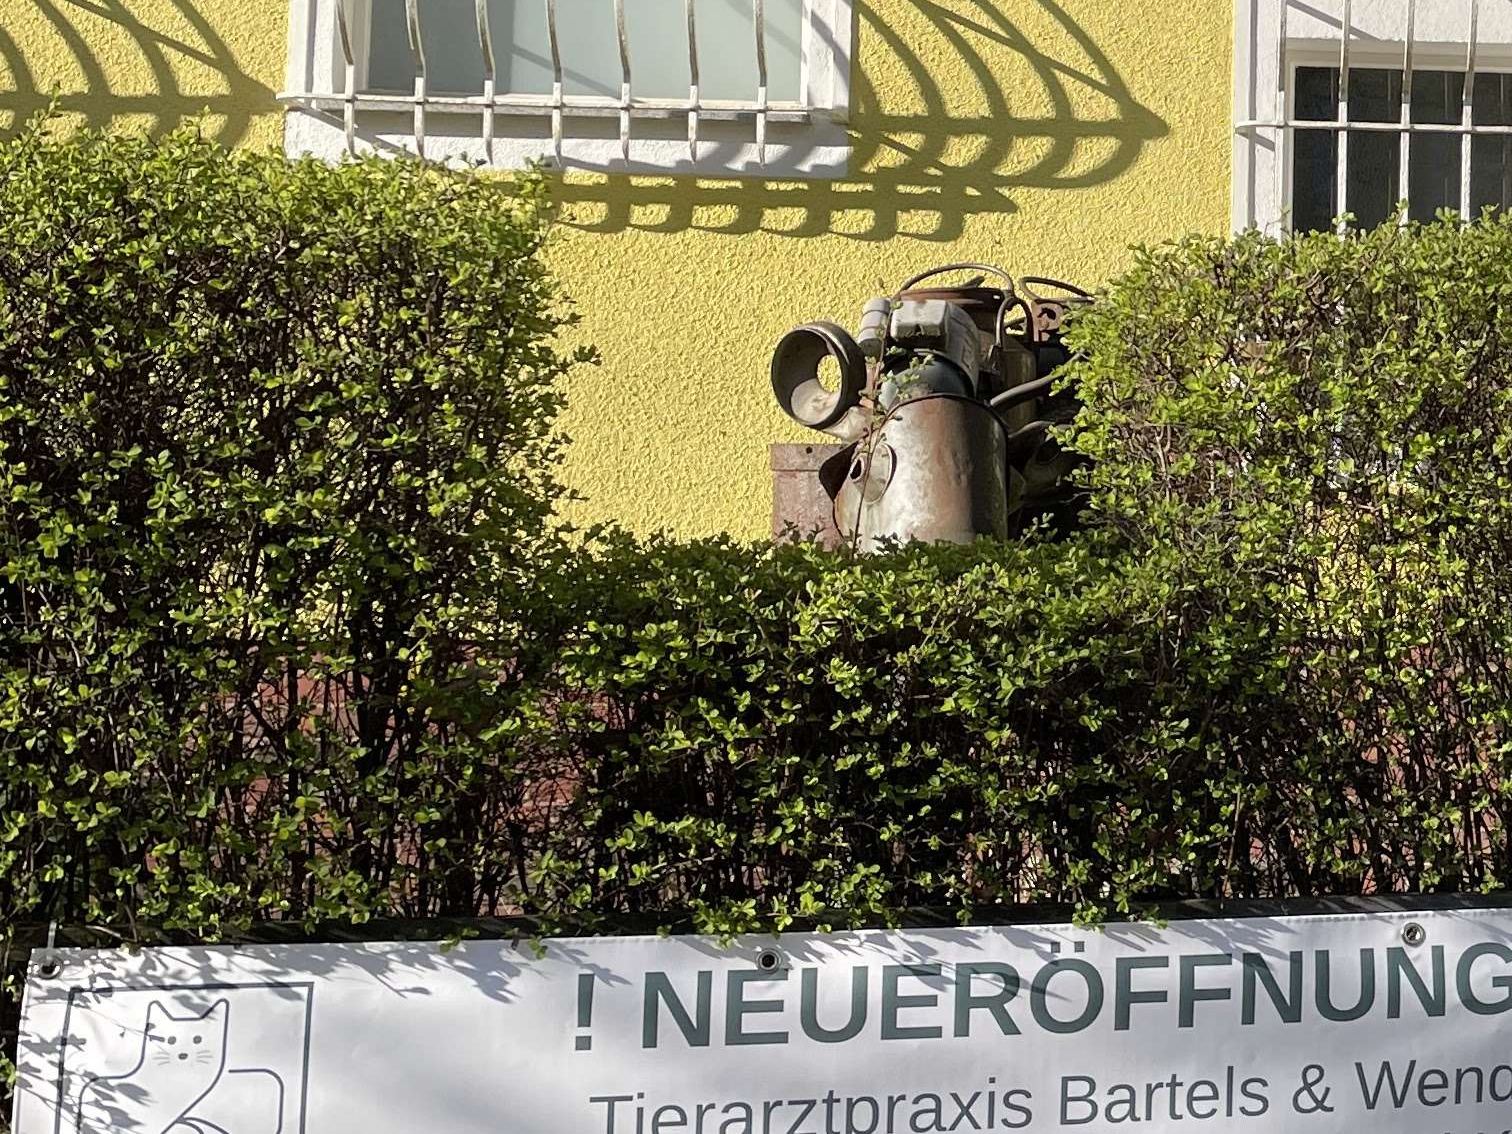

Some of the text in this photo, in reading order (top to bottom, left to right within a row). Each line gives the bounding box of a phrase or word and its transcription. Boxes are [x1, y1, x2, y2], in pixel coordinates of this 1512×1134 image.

[573, 973, 596, 1052] !
[589, 1077, 1033, 1134] Tierarztpraxis
[1060, 1066, 1269, 1125] Bartels
[1292, 1064, 1335, 1114] &
